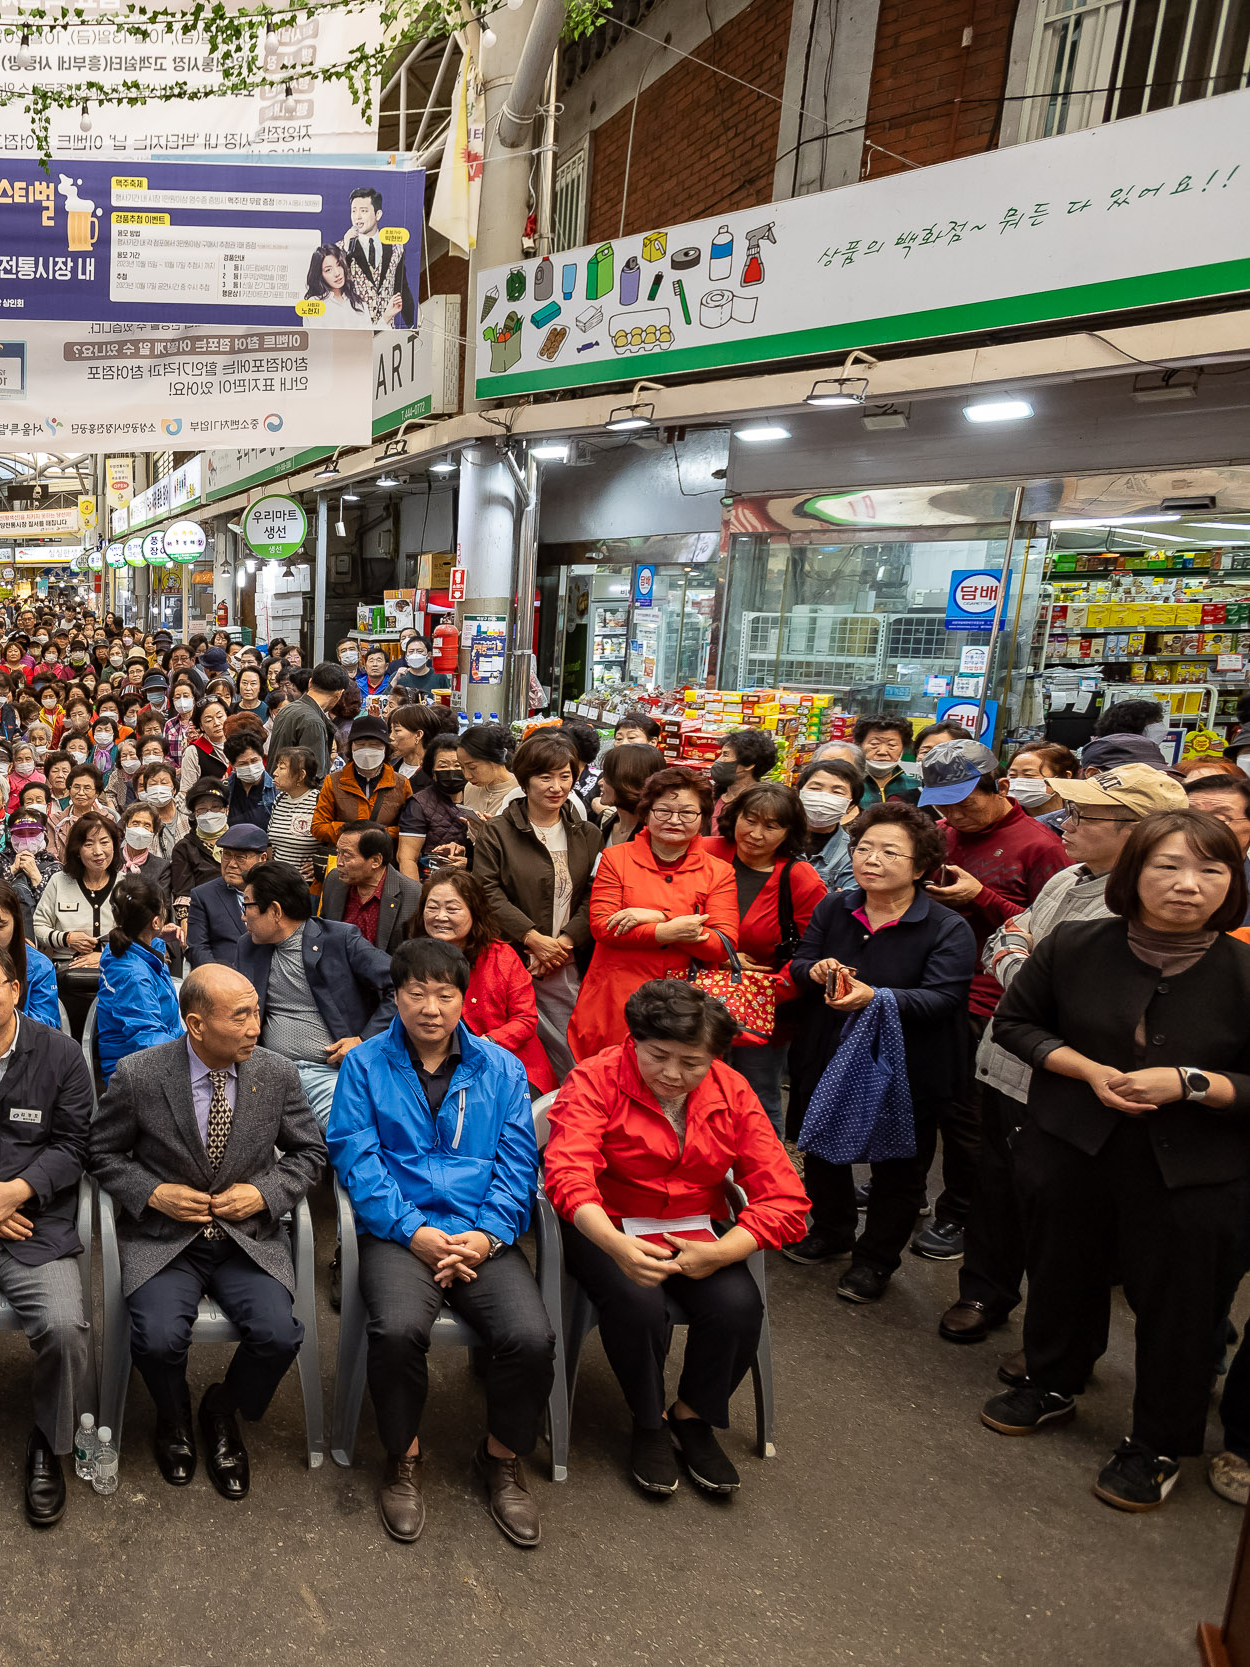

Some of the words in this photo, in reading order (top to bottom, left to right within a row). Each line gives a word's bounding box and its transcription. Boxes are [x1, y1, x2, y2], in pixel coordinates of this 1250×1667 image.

[144, 215, 166, 225] 이벤트
[817, 239, 886, 268] 상품의
[998, 200, 1051, 233] 뭐든
[1066, 197, 1095, 215] 다
[1106, 164, 1242, 211] 있어요!!
[78, 257, 95, 281] 내
[401, 401, 426, 421] T.444-0772
[252, 509, 298, 524] 우리마트
[263, 525, 286, 539] 생선
[268, 545, 283, 553] 생선
[960, 585, 999, 601] 담배
